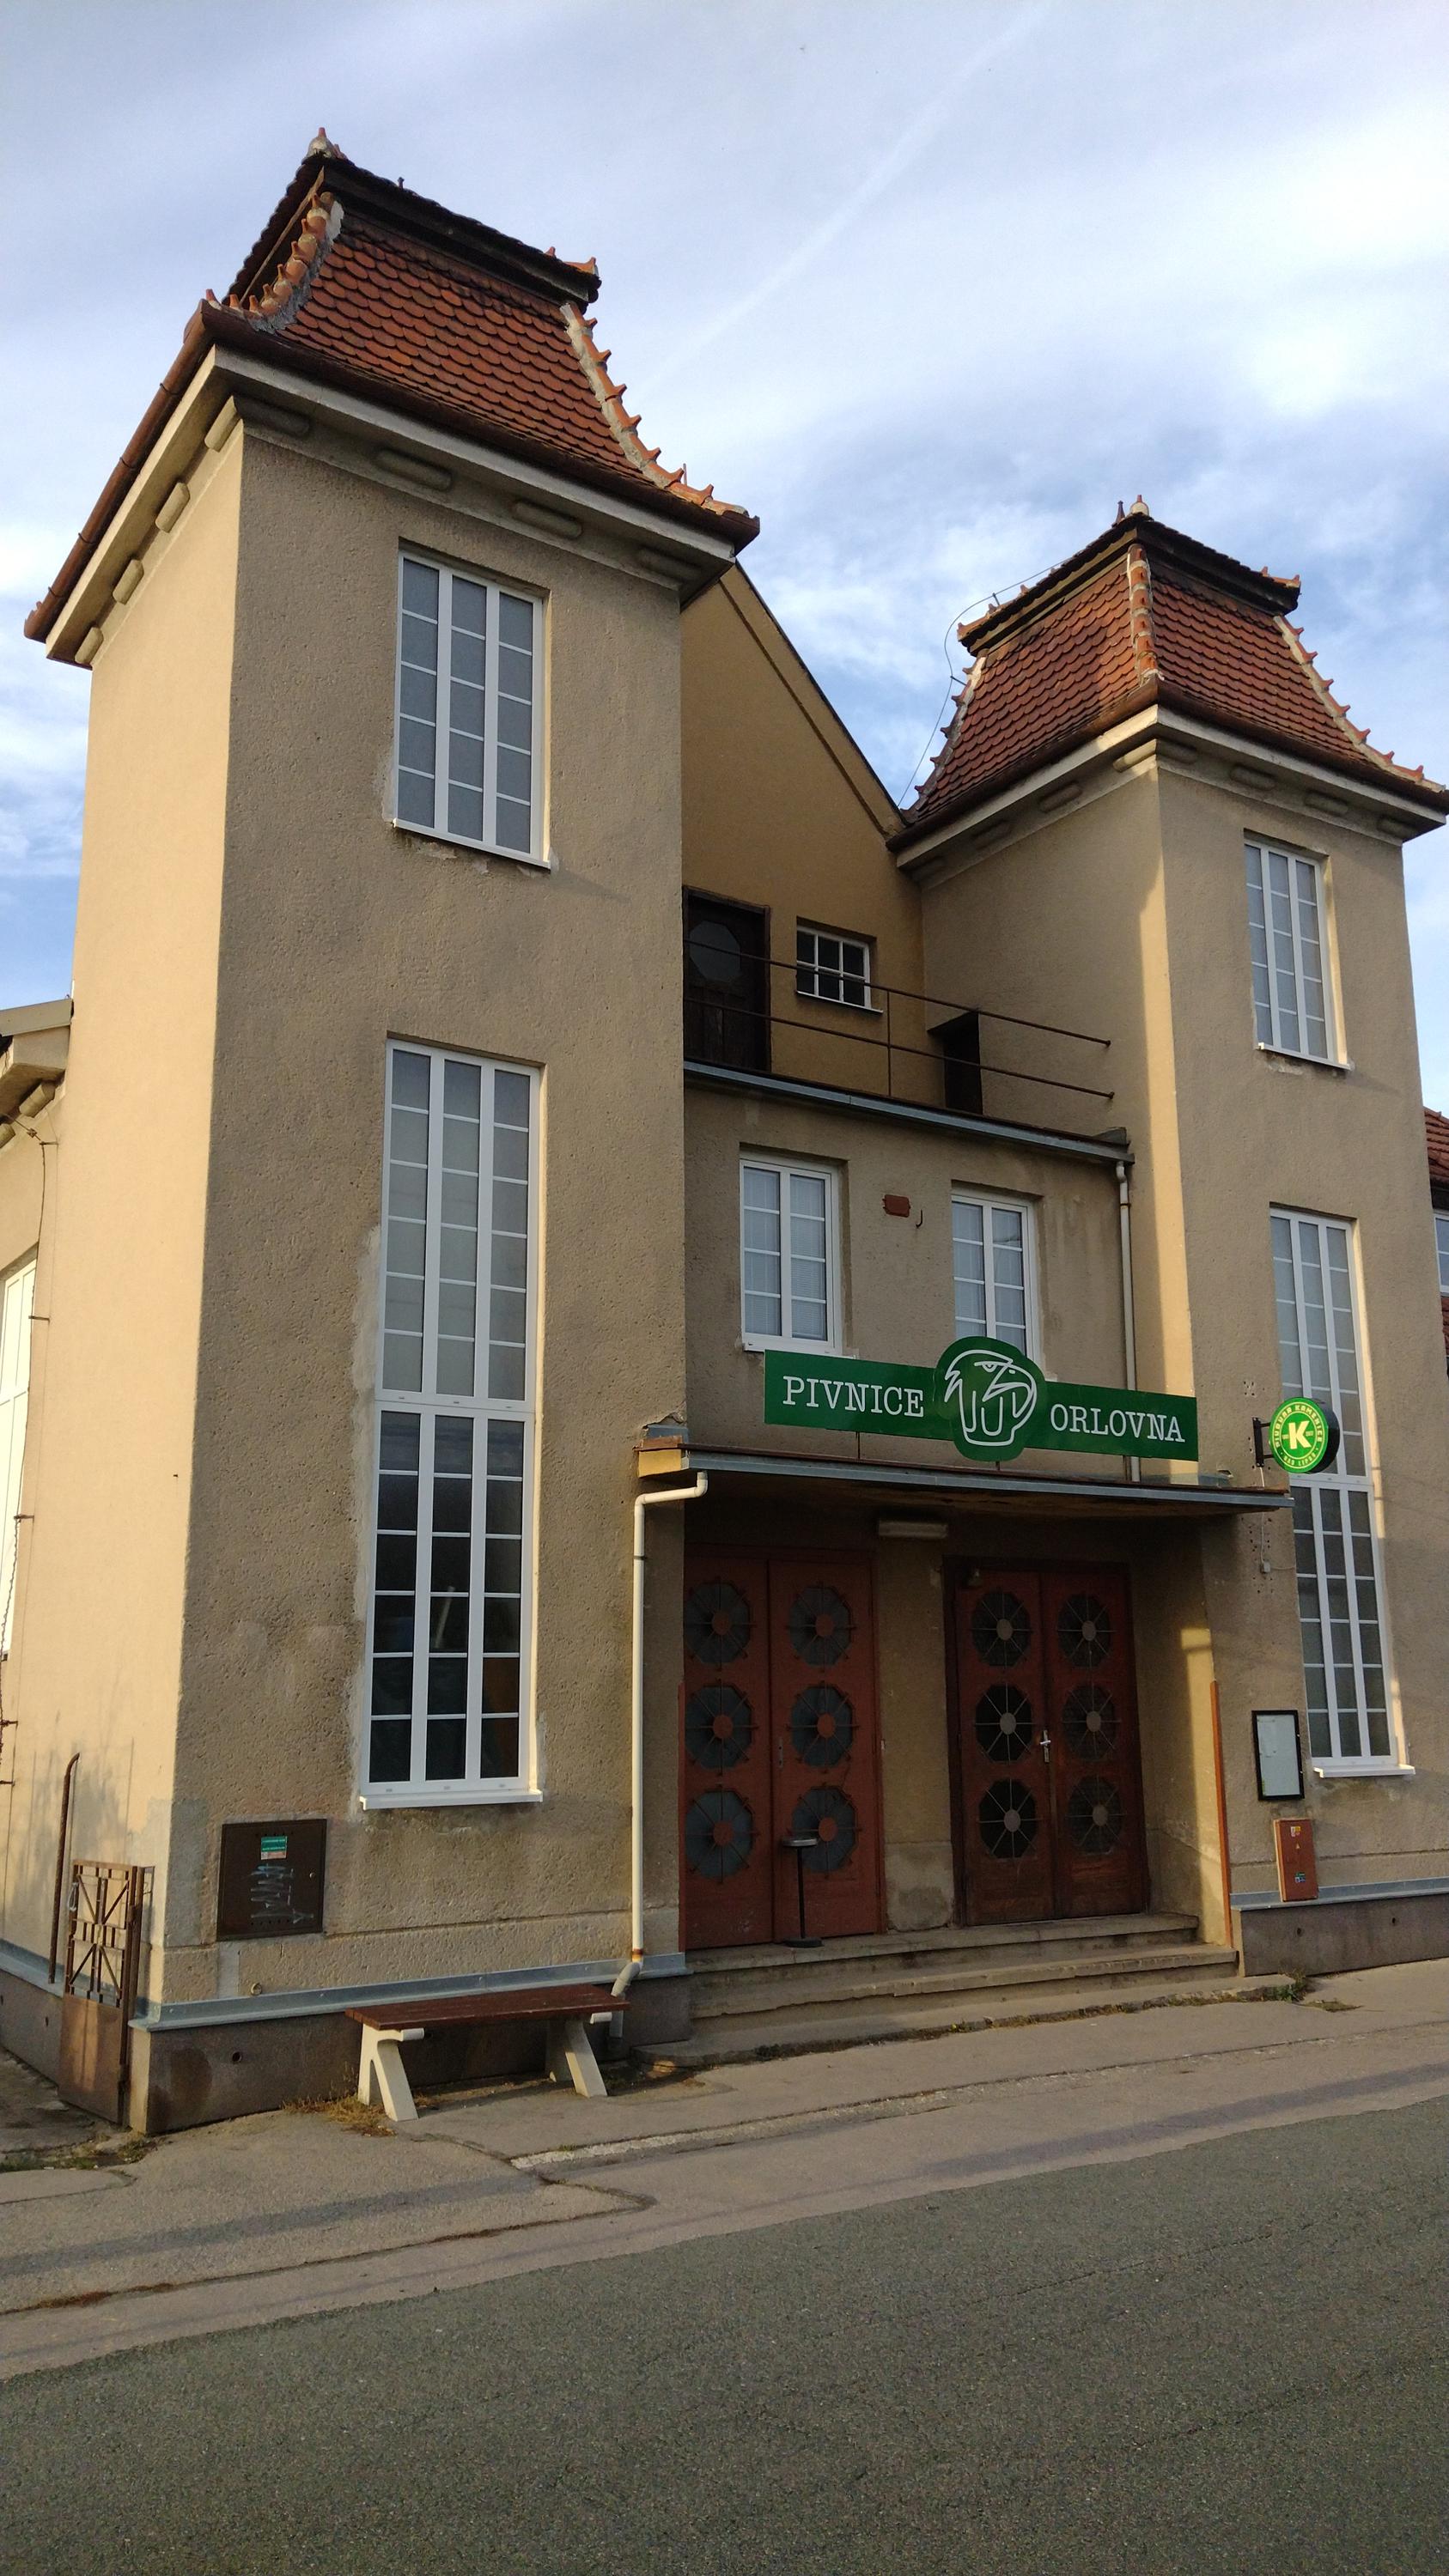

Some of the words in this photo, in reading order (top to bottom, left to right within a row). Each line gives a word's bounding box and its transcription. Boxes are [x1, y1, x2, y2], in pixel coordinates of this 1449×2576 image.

[782, 1375, 924, 1417] PIVNICE
[1050, 1403, 1185, 1443] ORLOVNA
[1288, 1420, 1312, 1449] K
